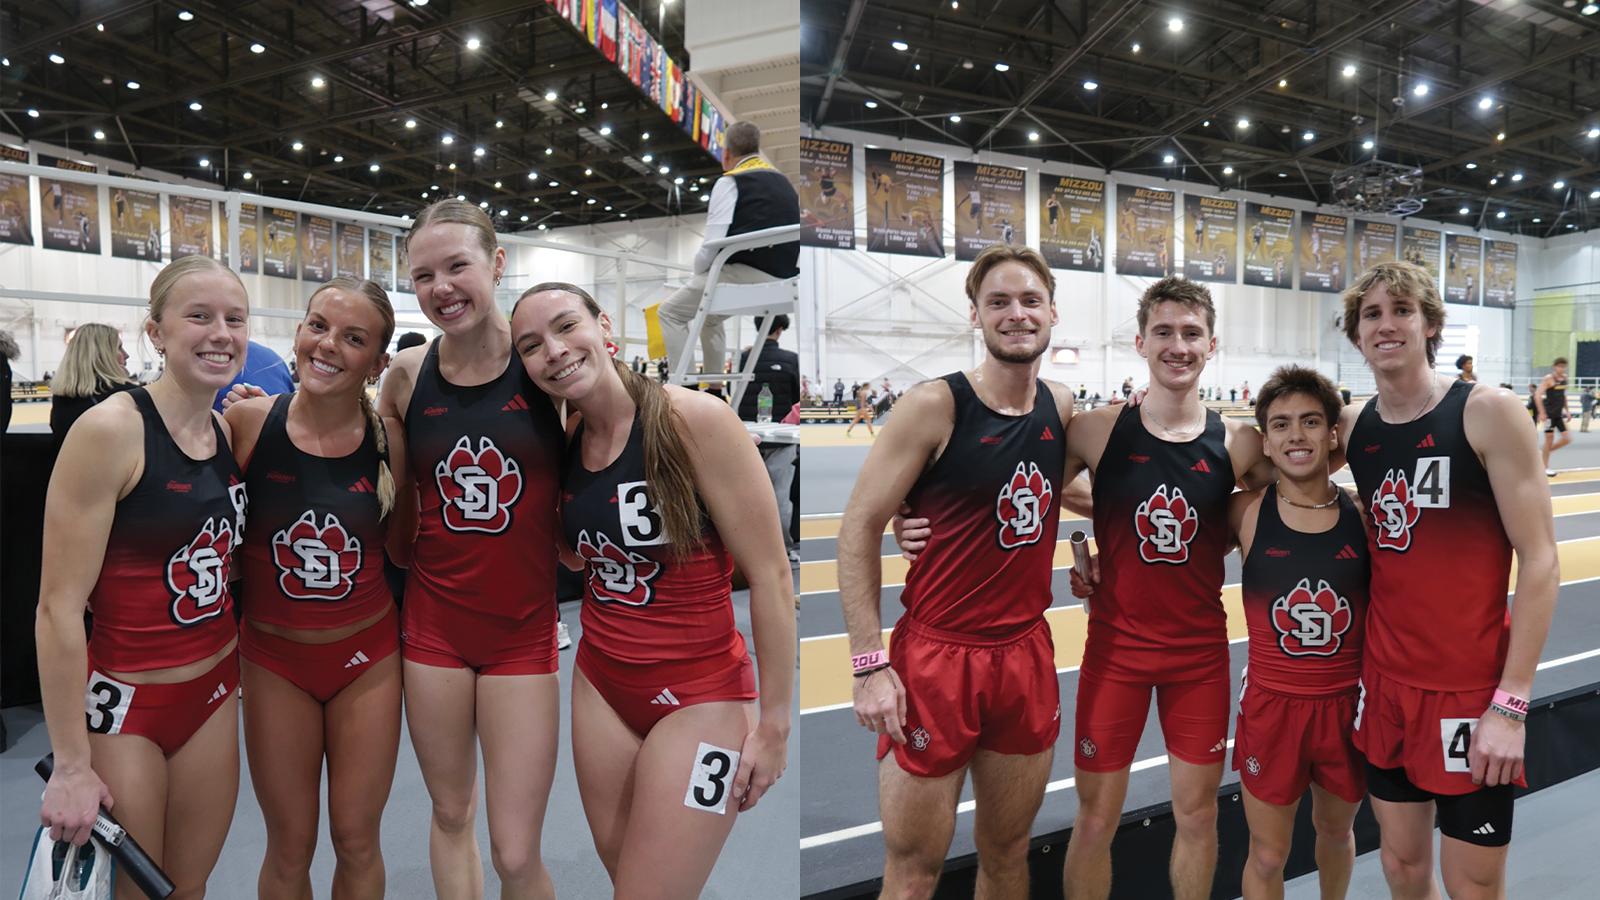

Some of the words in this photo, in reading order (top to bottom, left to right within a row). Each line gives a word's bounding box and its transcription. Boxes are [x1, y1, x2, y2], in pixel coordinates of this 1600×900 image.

[890, 152, 942, 168] MIZZOU
[976, 165, 1024, 180] MIZZOU
[1059, 177, 1103, 191] MIZZOU
[1135, 188, 1174, 201] MIZZOU
[1200, 197, 1237, 210] MIZZOU
[1260, 206, 1295, 218] MIZZOU
[1315, 214, 1346, 226] MIZZOU
[1366, 222, 1395, 233] MIZZOU
[266, 473, 296, 483] SUMMIT
[453, 465, 498, 521] SD
[1416, 460, 1444, 504] 4
[625, 485, 661, 541] 3
[1010, 487, 1040, 536] SD
[1149, 508, 1182, 553] SD
[1380, 493, 1408, 539] SD
[188, 547, 224, 608] SD
[292, 537, 340, 589] SD
[1290, 603, 1332, 646] SD
[86, 681, 121, 734] 3
[1448, 722, 1472, 768] 4
[694, 751, 731, 807] 3
